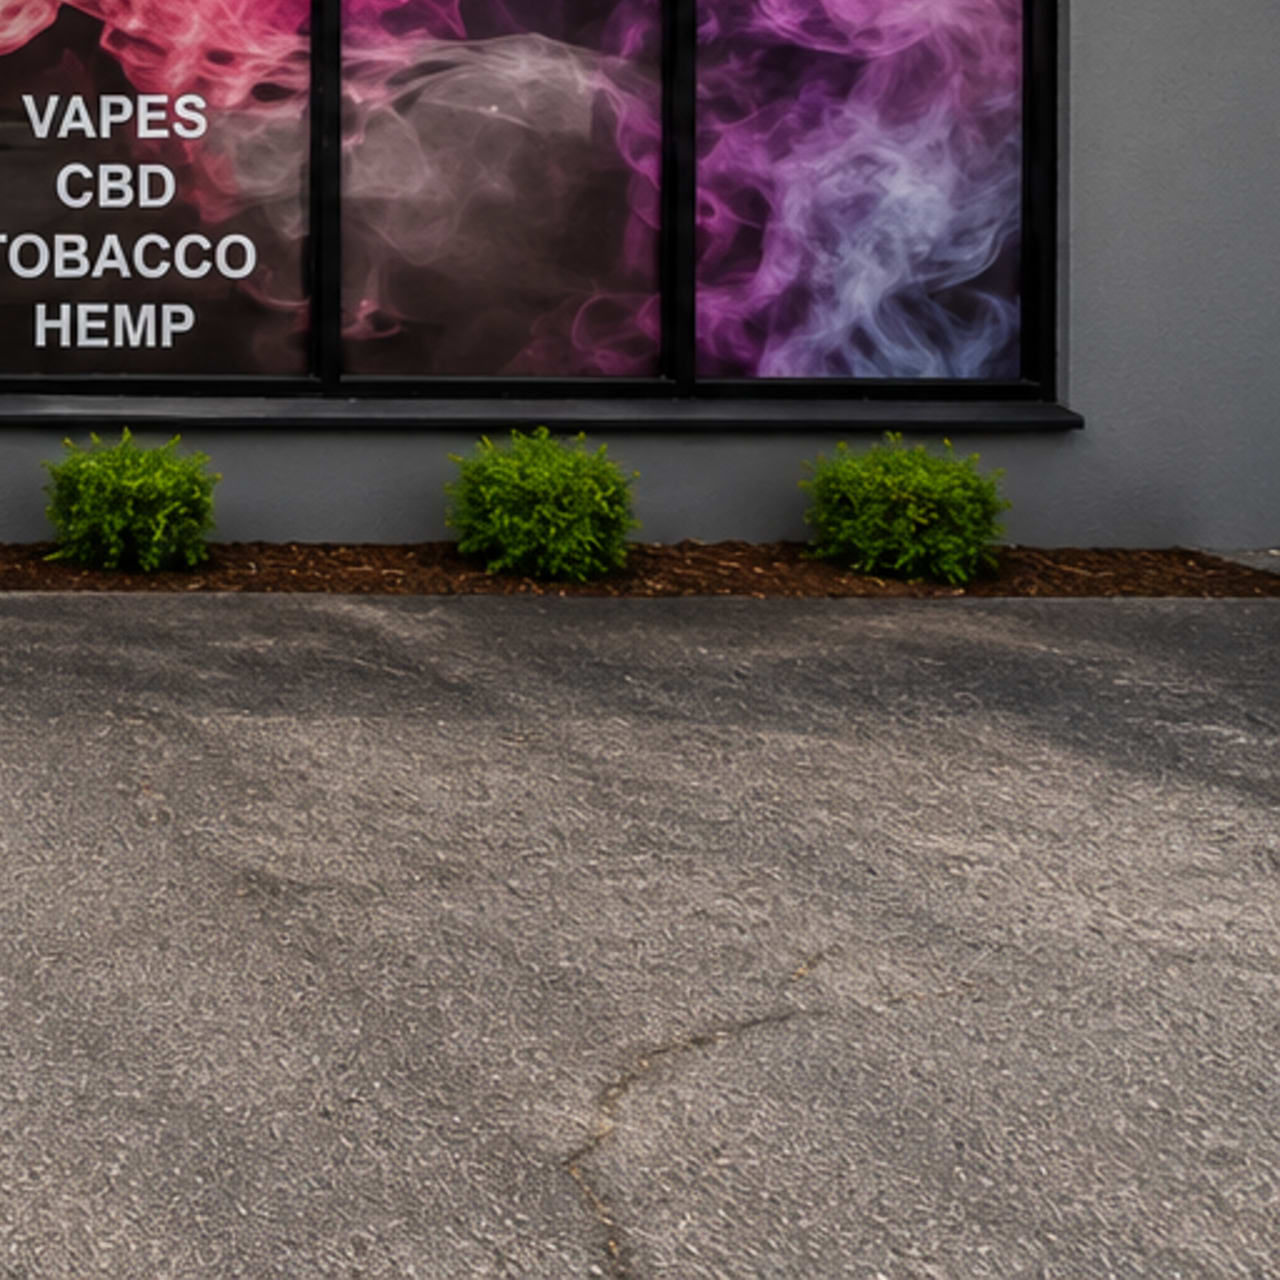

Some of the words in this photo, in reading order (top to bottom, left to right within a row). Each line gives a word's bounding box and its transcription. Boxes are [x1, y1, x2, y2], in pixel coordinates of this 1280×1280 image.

[22, 94, 208, 139] VAPES
[57, 163, 176, 208] CBD
[36, 304, 194, 347] HEMP
